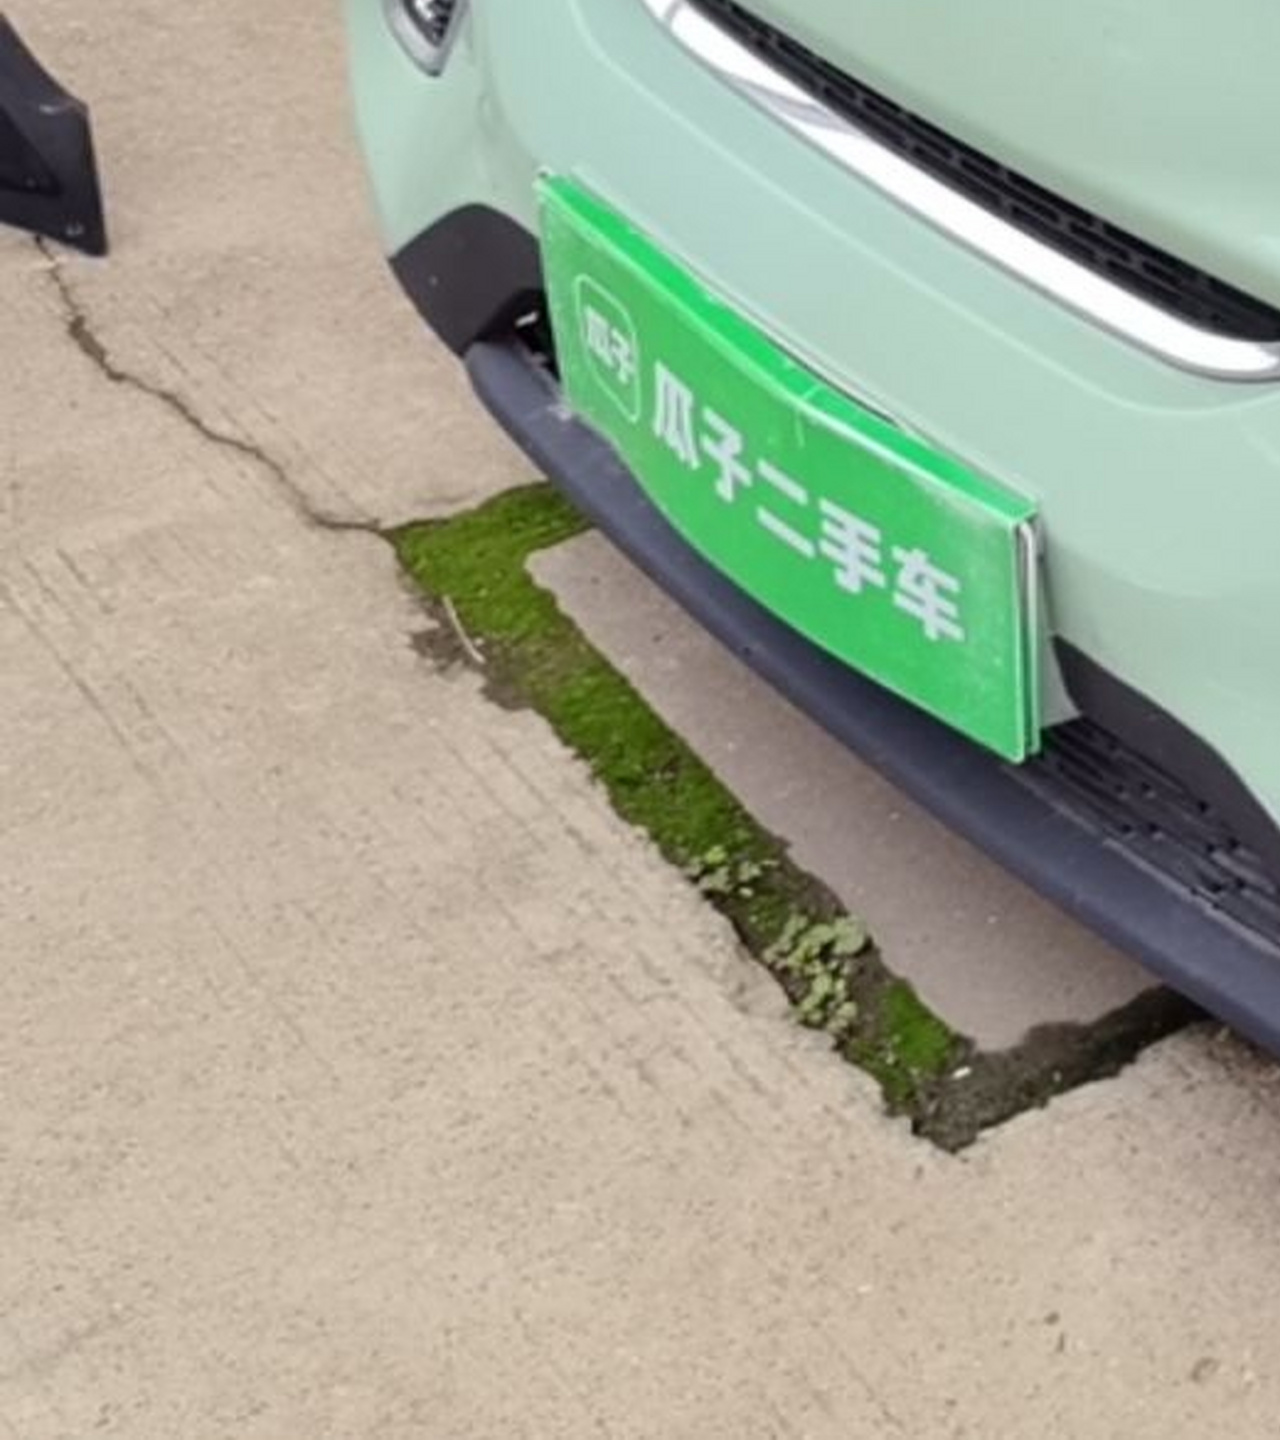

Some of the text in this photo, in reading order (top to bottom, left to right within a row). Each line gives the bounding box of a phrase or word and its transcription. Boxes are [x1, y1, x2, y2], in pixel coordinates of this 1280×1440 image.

[584, 305, 635, 385] 瓜子
[653, 358, 966, 643] 瓜子二手车
